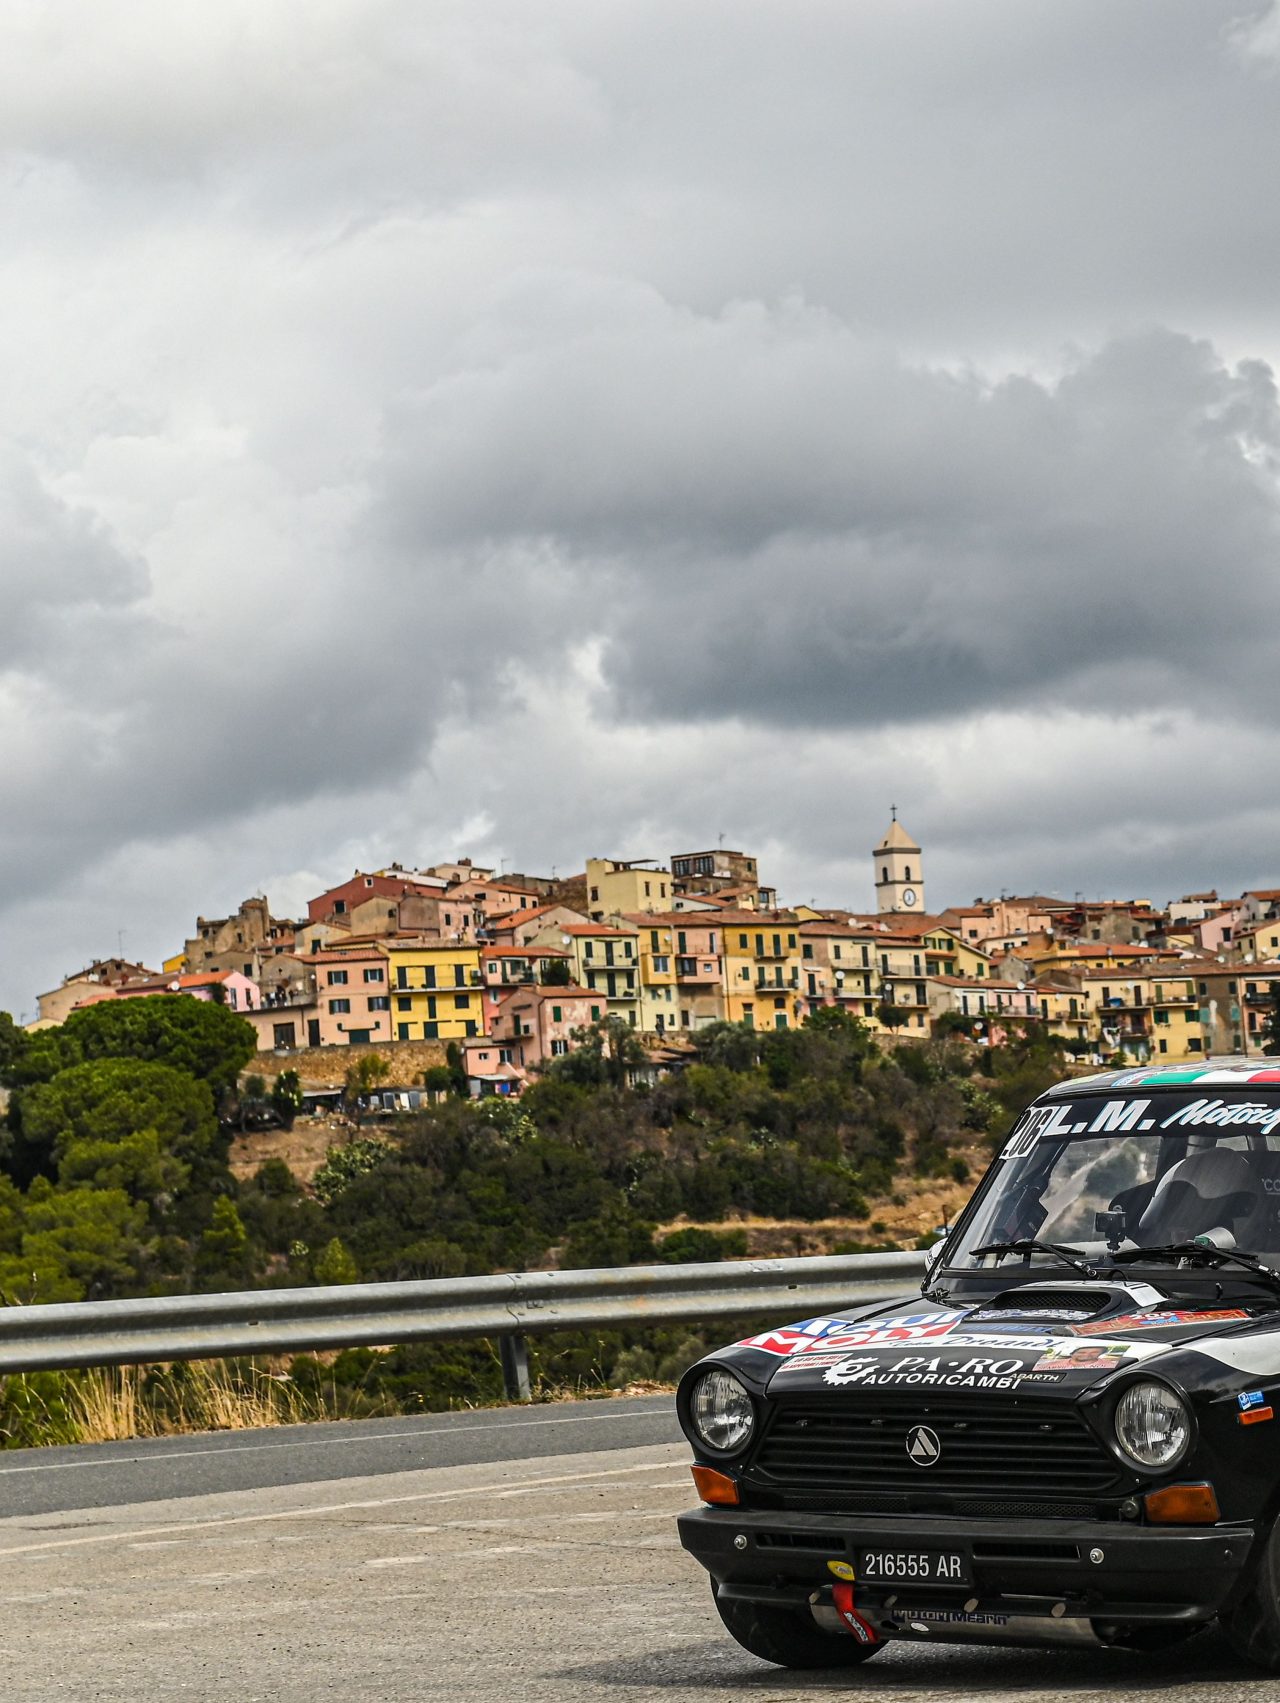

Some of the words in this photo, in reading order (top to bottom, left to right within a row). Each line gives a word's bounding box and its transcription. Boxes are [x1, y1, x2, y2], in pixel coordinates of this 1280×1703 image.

[751, 1325, 940, 1353] MOLY
[861, 1372, 1022, 1390] AUTORICAMBI
[1009, 1372, 1060, 1382] ABARTH
[865, 1553, 930, 1577] 216555
[936, 1555, 961, 1577] AR
